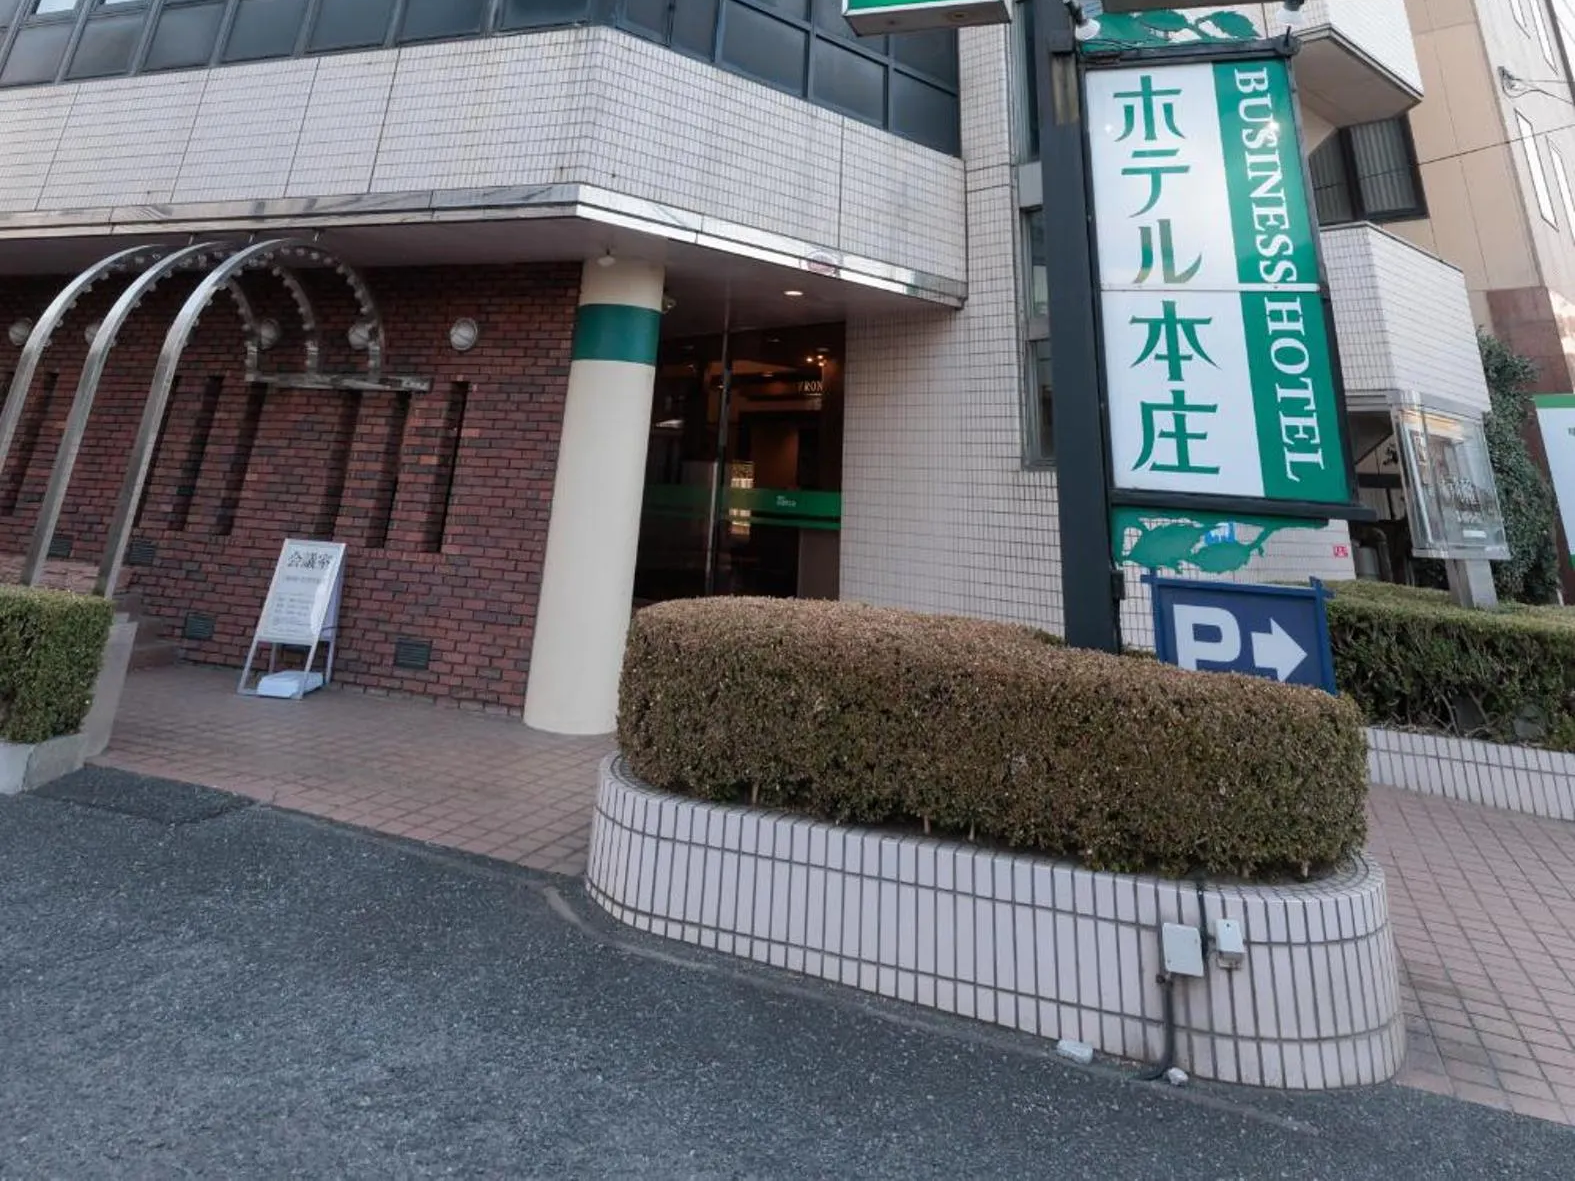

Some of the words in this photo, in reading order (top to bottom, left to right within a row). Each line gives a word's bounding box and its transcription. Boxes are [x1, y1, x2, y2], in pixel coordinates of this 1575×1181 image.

[1112, 74, 1223, 475] ホテル本庄
[1233, 67, 1299, 284] BUSINESS
[1263, 296, 1327, 482] HOTEL
[1172, 603, 1242, 672] P
